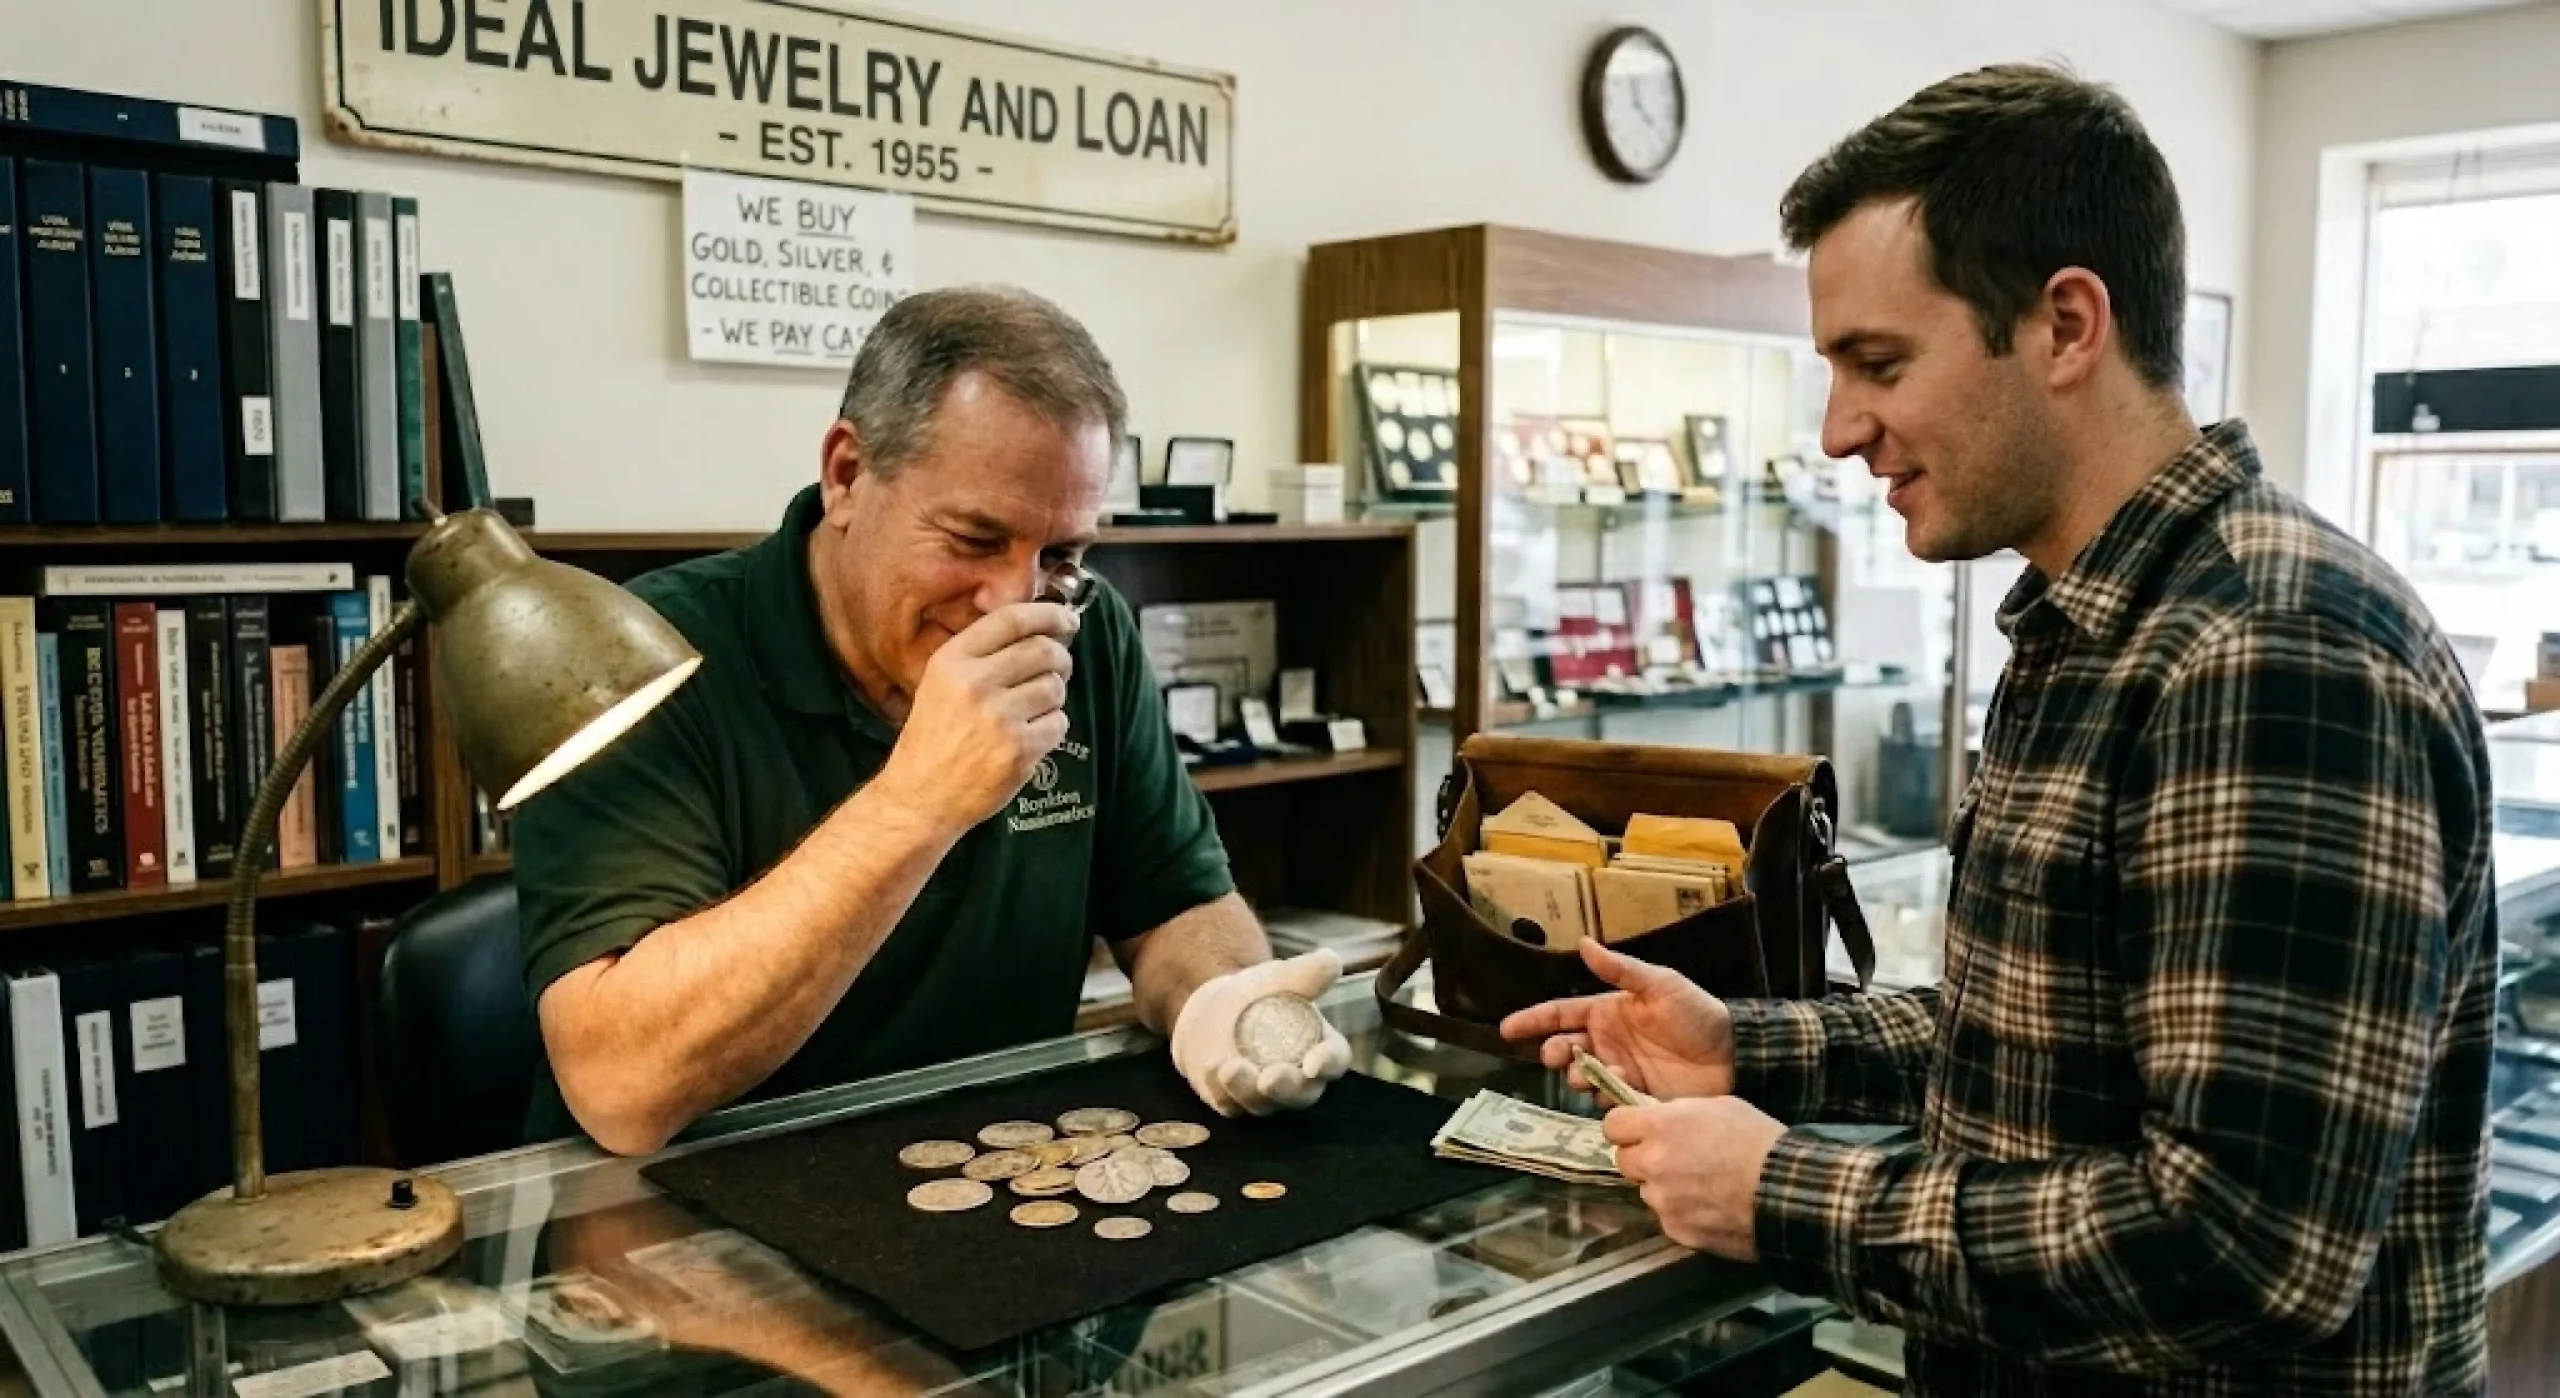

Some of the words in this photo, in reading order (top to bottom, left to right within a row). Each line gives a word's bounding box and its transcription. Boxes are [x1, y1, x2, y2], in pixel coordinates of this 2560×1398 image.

[380, 0, 612, 82] IDEAL
[633, 14, 941, 127] JEWELRY
[960, 77, 1058, 143] AND
[1077, 85, 1207, 166] LOAN
[761, 121, 852, 169] EST.
[872, 138, 959, 182] 1955
[738, 194, 781, 226] WE
[798, 199, 855, 232] BUY
[692, 272, 839, 307] COLLECTIBLE
[847, 285, 908, 311] COIN
[720, 318, 759, 346] WE
[771, 320, 812, 348] PAY
